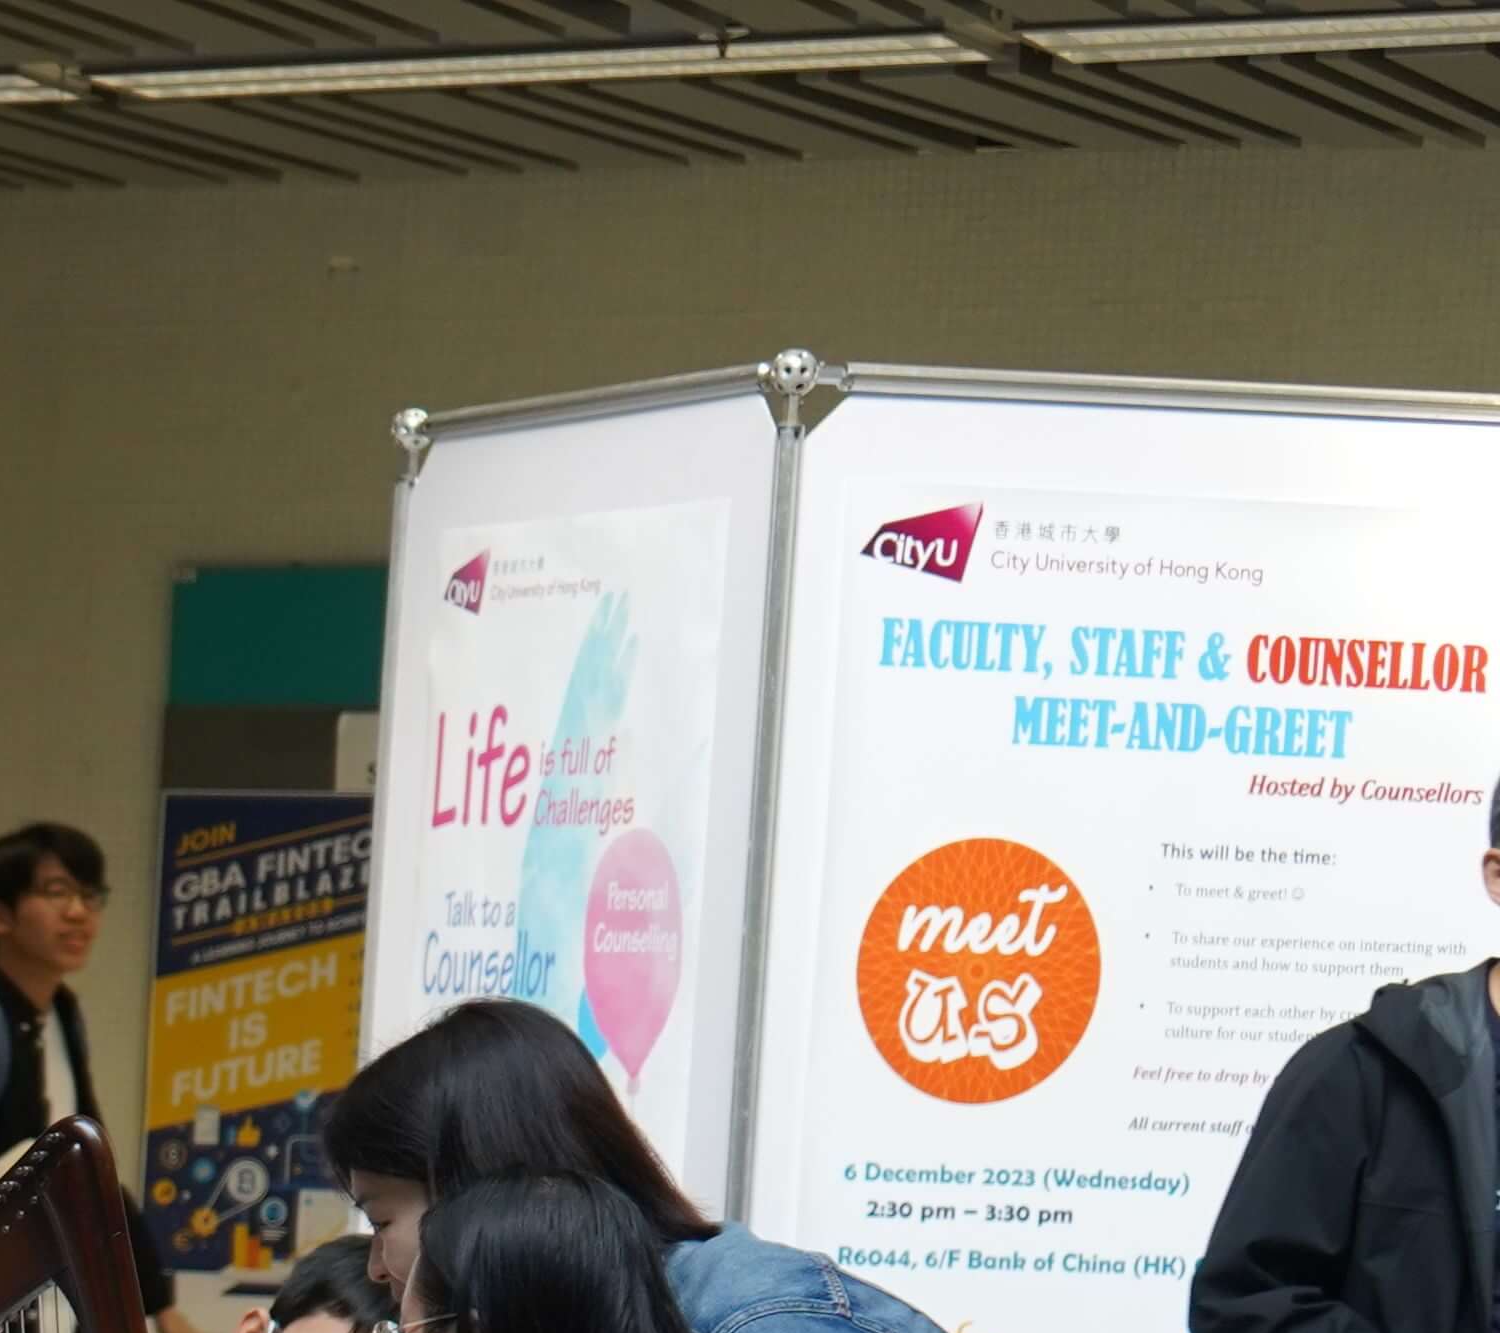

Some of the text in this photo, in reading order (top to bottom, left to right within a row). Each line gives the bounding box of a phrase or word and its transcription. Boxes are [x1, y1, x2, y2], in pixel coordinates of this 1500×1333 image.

[873, 530, 958, 572] CityU
[994, 519, 1121, 545] 香港城市大學
[991, 550, 1263, 586] City University of Hong Kong
[878, 616, 1490, 694] FACULTY, STAFF & COUNSELLOR
[1011, 695, 1353, 760] MEET-AND-GREET
[431, 704, 617, 829] Life is full of
[1249, 775, 1483, 804] Hosted by Counsellors
[533, 788, 635, 836] Challenges
[177, 821, 237, 856] JOIN
[1162, 843, 1337, 867] This will be the time:
[172, 828, 372, 901] GBA FINTEC
[445, 890, 516, 928] Talk to a
[606, 880, 669, 912] Personal
[897, 883, 1069, 957] meet
[593, 921, 679, 961] Counselling
[422, 929, 556, 998] Counsellor
[166, 953, 340, 1026] FINTECH
[228, 1011, 268, 1053] IS
[171, 1038, 323, 1106] FUTURE
[844, 1163, 1189, 1196] 6 December 2023 (Wednesday)
[868, 1201, 912, 1218] 2:30
[921, 1206, 955, 1222] pm
[986, 1205, 1030, 1222] 3:30
[1038, 1210, 1072, 1226] pm
[838, 1246, 1185, 1280] R6044, 6/F Bank of China (HK)
